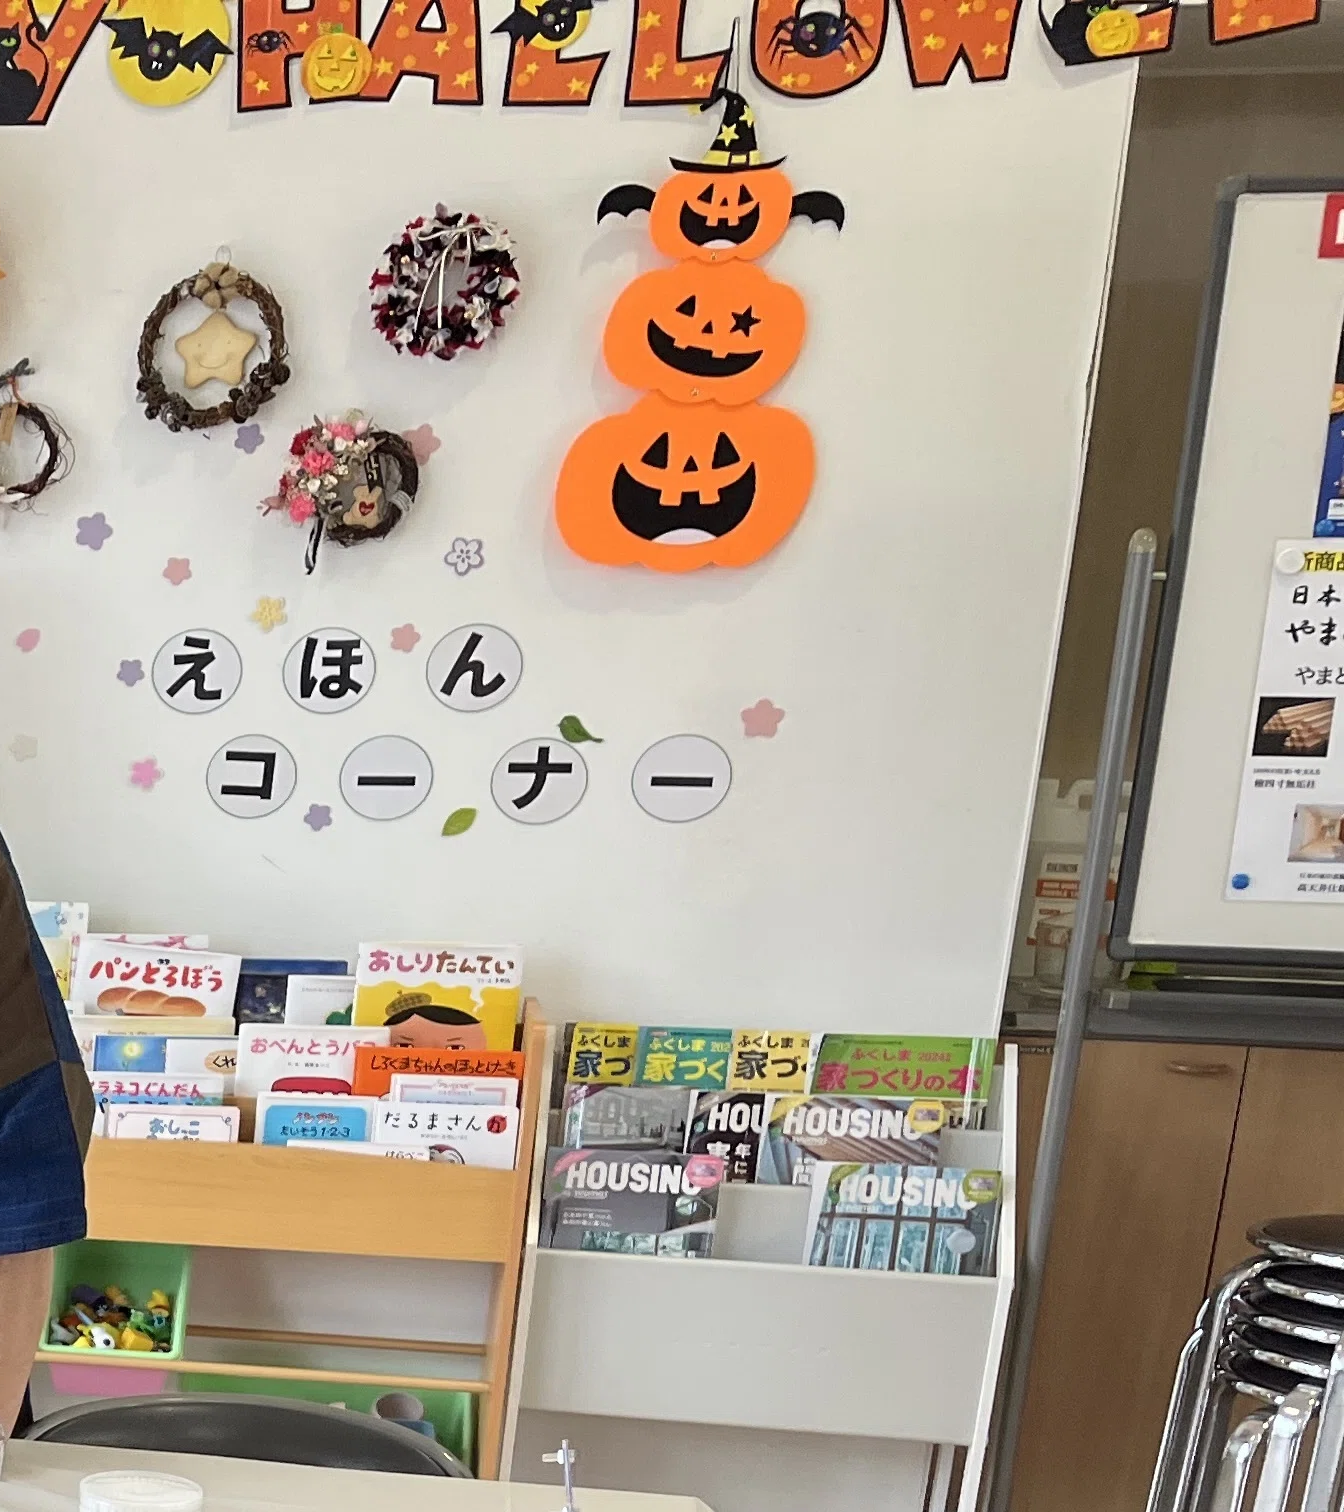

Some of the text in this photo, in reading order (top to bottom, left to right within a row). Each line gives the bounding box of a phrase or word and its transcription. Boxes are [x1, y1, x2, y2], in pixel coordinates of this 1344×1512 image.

[1292, 584, 1342, 606] 日本
[1284, 617, 1344, 646] やま
[165, 632, 506, 701] えほん
[220, 746, 714, 810] コーナー
[89, 957, 223, 992] パンどろぼう
[369, 949, 515, 975] おしりたんてい
[250, 1037, 376, 1057] おべんとうバ
[577, 1035, 631, 1048] ふくしま
[649, 1037, 706, 1051] ふくしま
[738, 1035, 793, 1048] ふくしま
[734, 1049, 806, 1080] 家づ
[851, 1049, 911, 1062] ふくしま
[816, 1060, 982, 1095] 家づくりの本
